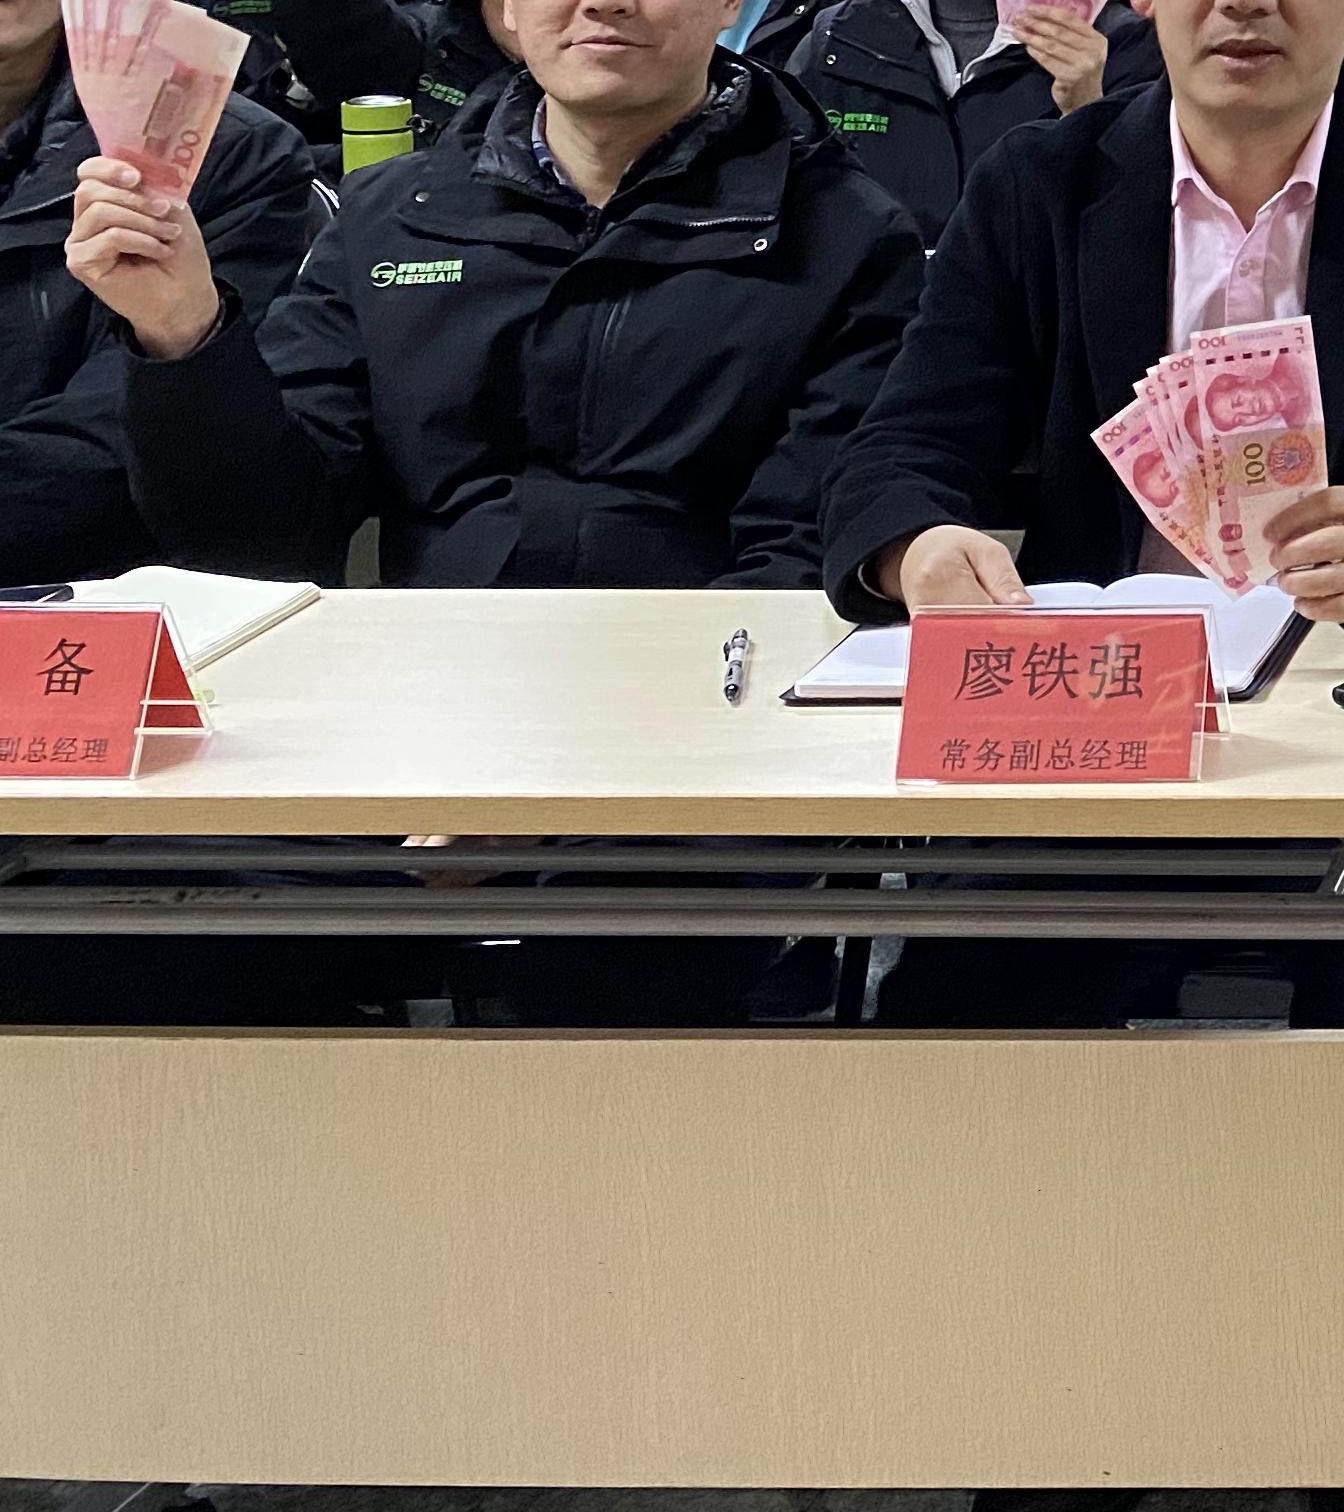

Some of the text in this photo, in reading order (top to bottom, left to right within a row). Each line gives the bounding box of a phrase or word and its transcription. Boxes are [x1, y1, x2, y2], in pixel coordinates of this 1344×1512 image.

[172, 129, 201, 168] 100
[1199, 336, 1226, 349] 100
[1242, 442, 1267, 486] 100
[36, 637, 95, 696] 备
[954, 641, 1144, 701] 廖铁强
[939, 738, 1149, 771] 常务副总经理
